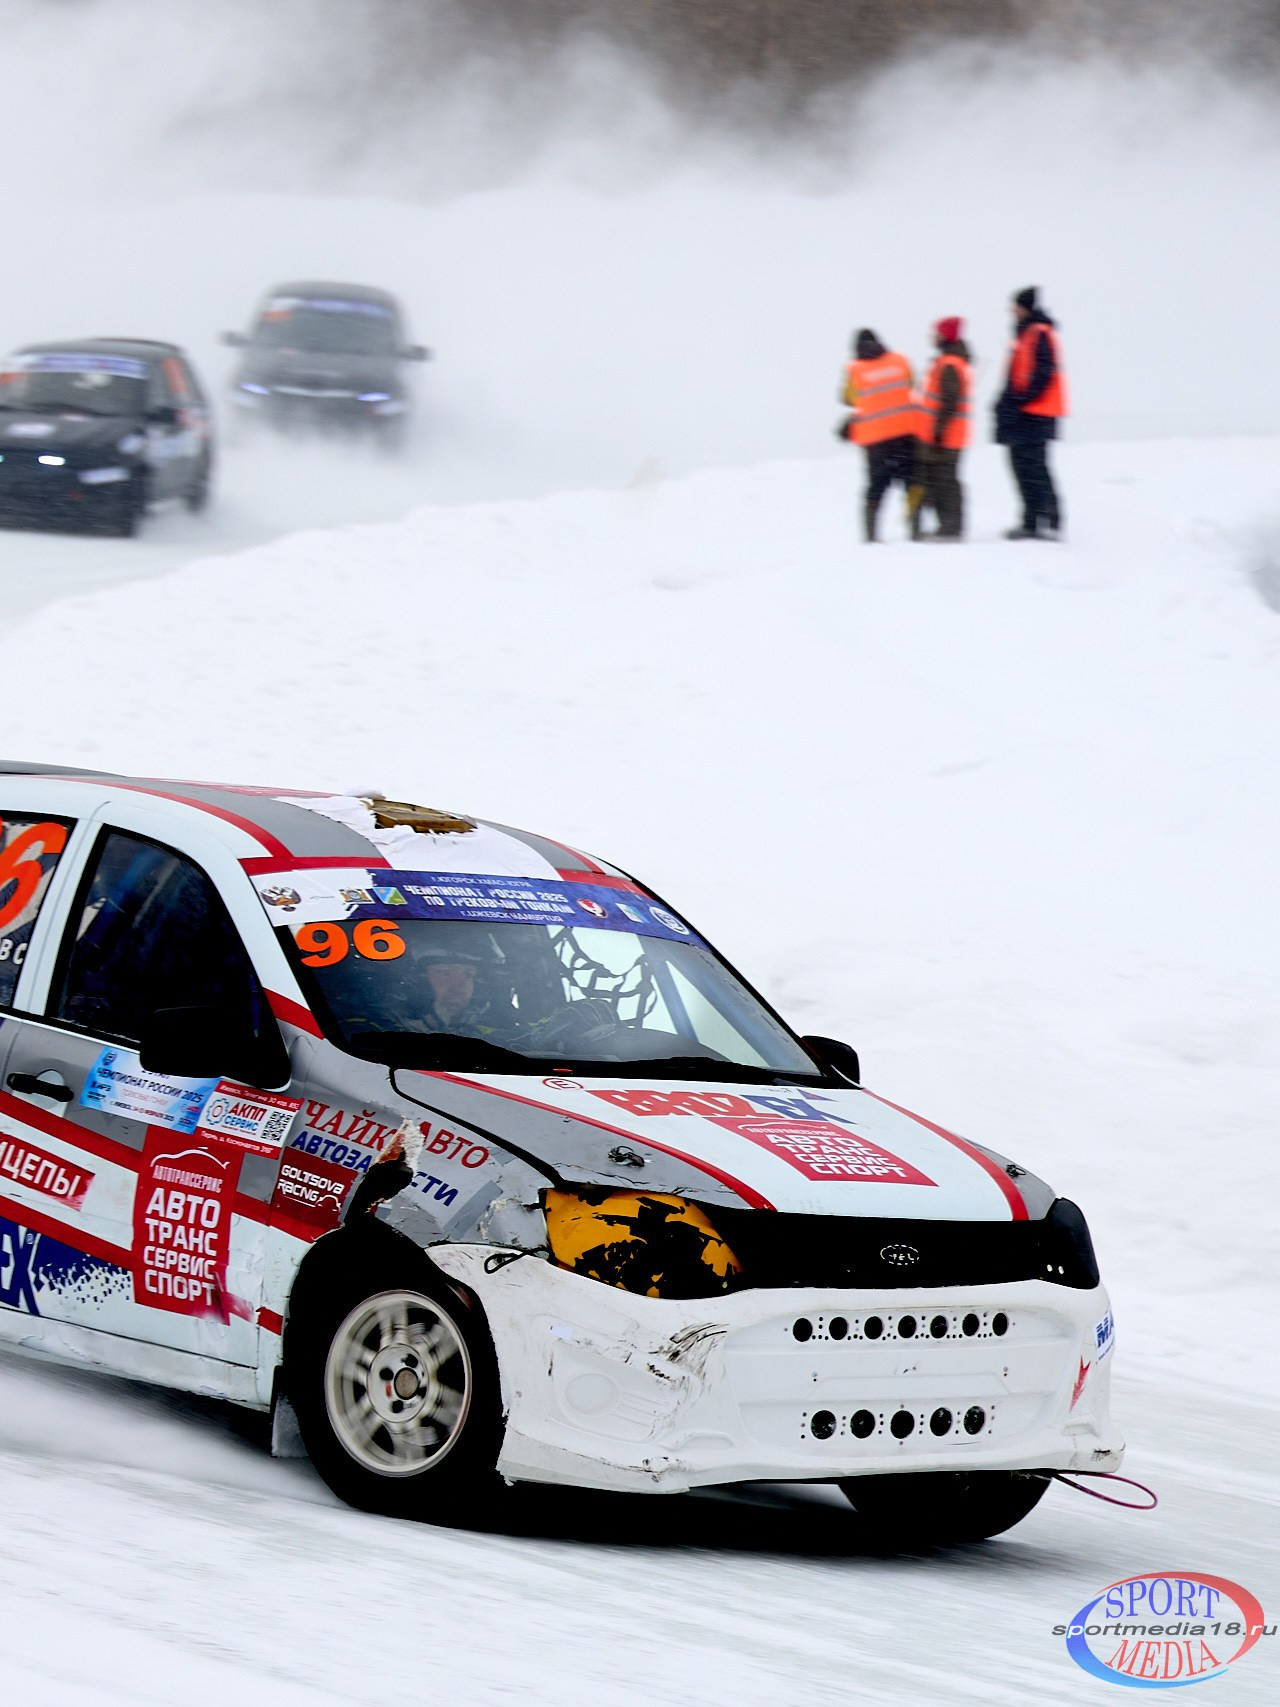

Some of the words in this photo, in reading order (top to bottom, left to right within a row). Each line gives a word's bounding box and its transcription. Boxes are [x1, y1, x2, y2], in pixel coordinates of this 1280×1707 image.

[403, 884, 485, 898] ЧЕМПИОНАТ
[490, 889, 538, 901] РОССИИ
[536, 892, 569, 903] 2025
[423, 896, 446, 907] ПО
[520, 902, 576, 915] ГОНКАМ
[12, 942, 28, 965] С
[296, 919, 406, 968] 96
[97, 1067, 149, 1089] ЧЕМПИОНАТ
[147, 1081, 183, 1098] РОССИИ
[181, 1090, 205, 1103] 2025
[228, 1102, 268, 1122] АКПП
[224, 1115, 259, 1132] СЕРВИС
[765, 1133, 863, 1148] АВТО
[776, 1142, 882, 1157] ТРАНС
[794, 1153, 900, 1167] СЕРВИС
[809, 1163, 907, 1178] СПОРТ
[152, 1164, 223, 1194] АВТОТРАНССЕРВИС
[145, 1187, 221, 1229] АВТО
[144, 1217, 218, 1257] ТРАНС
[143, 1245, 217, 1280] СЕРВИС
[144, 1269, 216, 1306] СПОРТ
